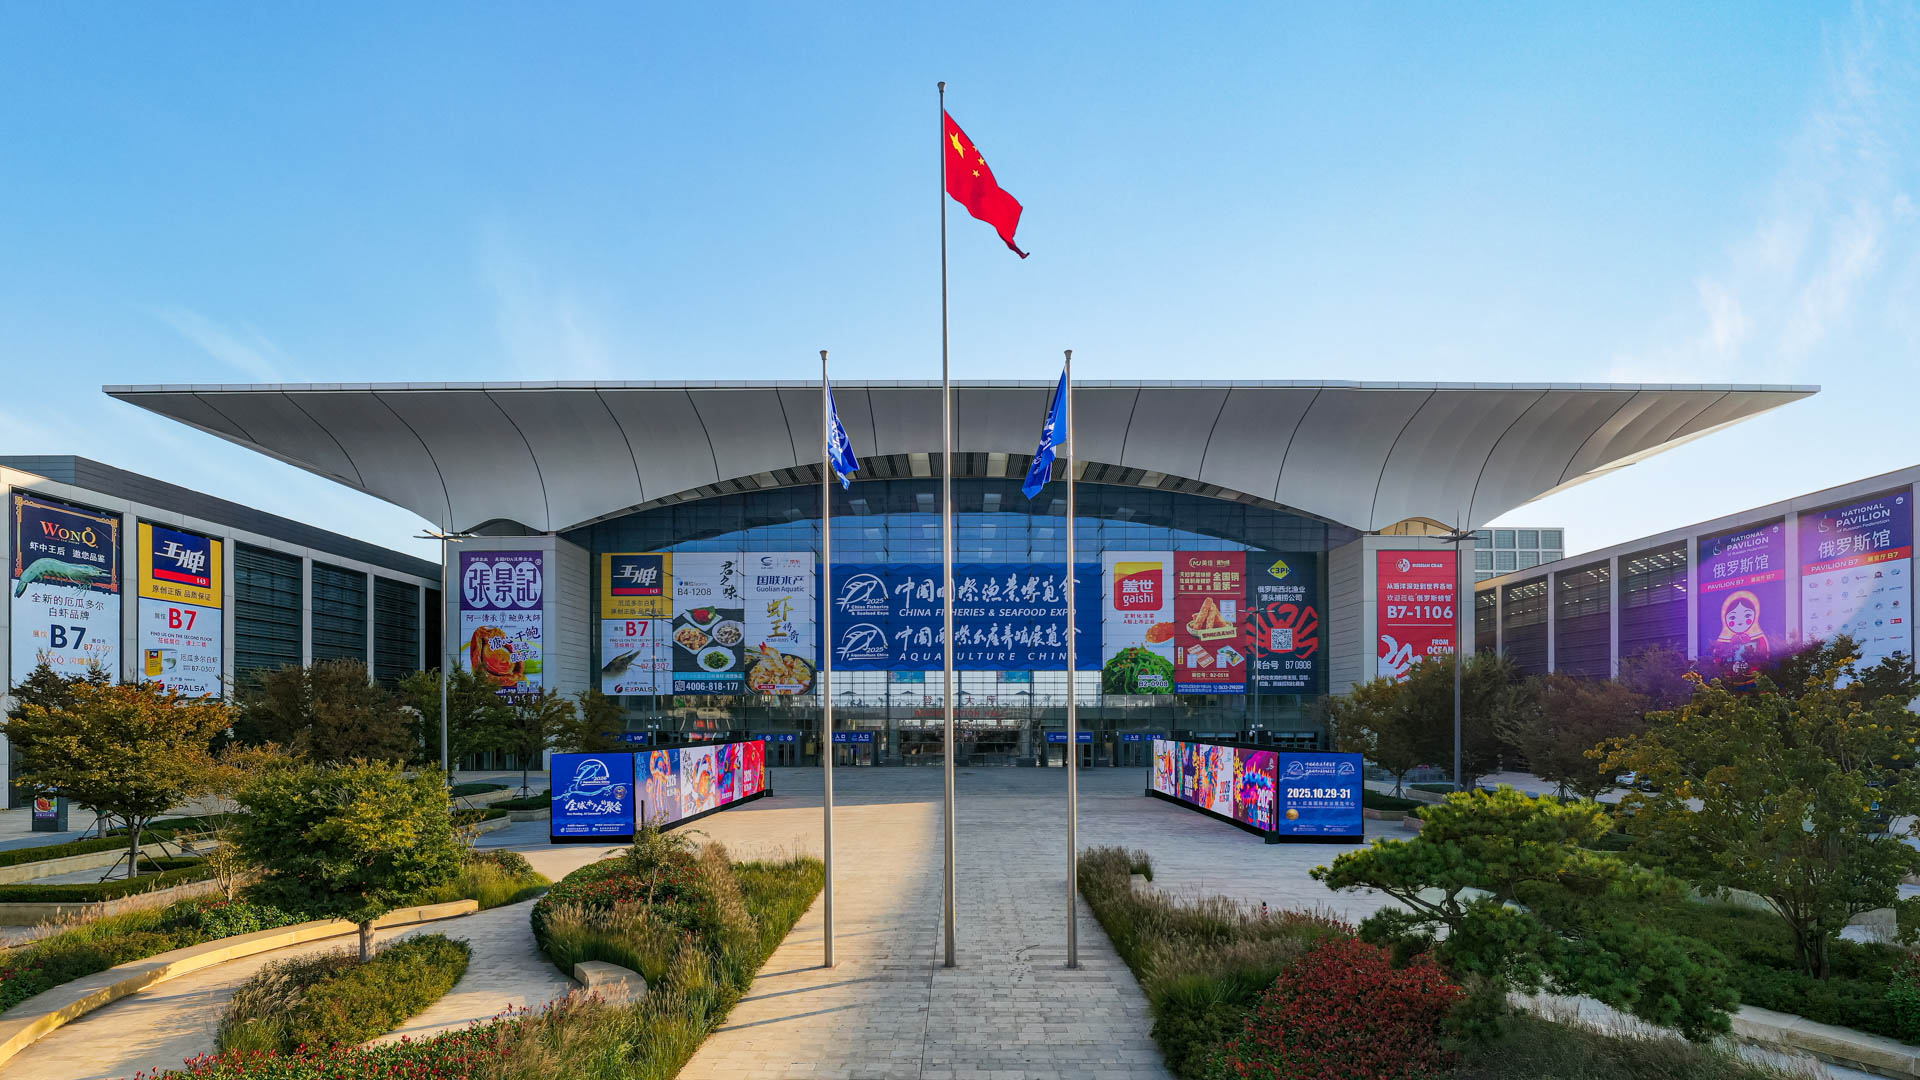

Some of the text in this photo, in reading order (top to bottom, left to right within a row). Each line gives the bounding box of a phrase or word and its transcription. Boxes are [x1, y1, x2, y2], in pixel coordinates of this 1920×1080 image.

[1841, 503, 1884, 517] NATIONAL
[1836, 509, 1890, 527] PAVILION
[1727, 537, 1769, 551] PAVILION
[1730, 531, 1764, 543] NATIONAL
[1818, 529, 1890, 559] 俄罗斯馆
[29, 541, 66, 556] 虾中王后
[1887, 551, 1899, 560] B7
[1713, 554, 1769, 579] 俄罗斯馆
[1811, 561, 1847, 572] PAVILION
[613, 565, 658, 586] 王牌
[757, 576, 804, 585] 国联水产
[469, 568, 538, 602] 張景記
[678, 588, 712, 596] B4-1208
[781, 586, 805, 594] Aquatic
[1123, 579, 1154, 593] 盖世
[1707, 580, 1735, 590] PAVILION
[152, 584, 212, 602] 原创正版 品质保证
[1123, 593, 1154, 607] gaishi
[31, 593, 105, 611] 全新的厄瓜多尔
[49, 607, 90, 621] 白虾品牌
[899, 609, 931, 617] CHINA
[936, 609, 985, 617] FIHERIES
[988, 609, 995, 617] &
[999, 609, 1046, 617] SEAFOOD
[1387, 605, 1453, 618] B7-1106
[168, 607, 198, 631] B7
[626, 621, 649, 636] B7
[50, 624, 87, 650] B7
[181, 653, 218, 663] 厄瓜多尔白虾
[899, 652, 1016, 661] AQUAULTURE
[686, 682, 739, 691] 4006-818-177
[1287, 788, 1351, 799] 2025.10.29-31
